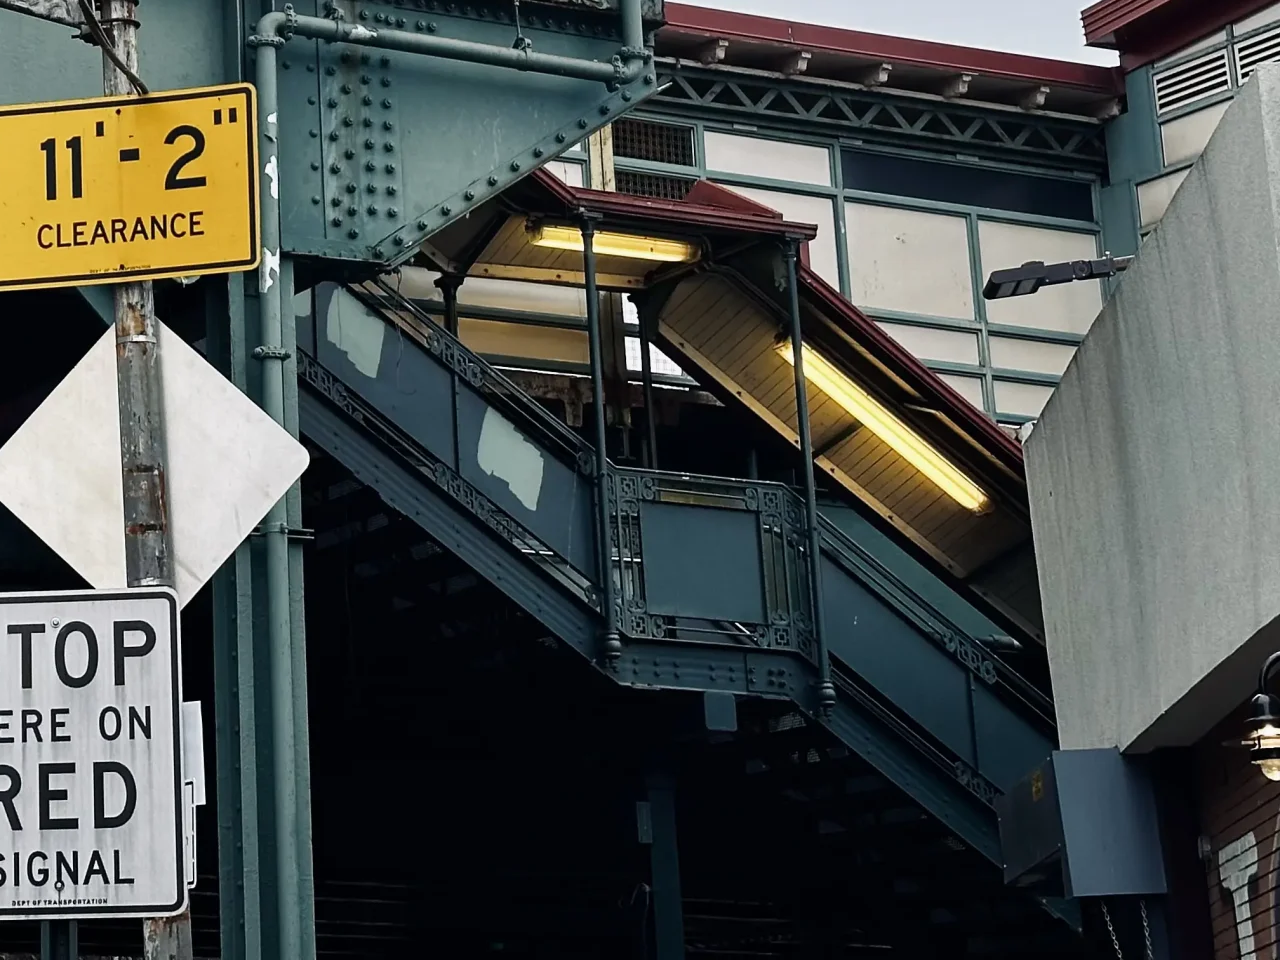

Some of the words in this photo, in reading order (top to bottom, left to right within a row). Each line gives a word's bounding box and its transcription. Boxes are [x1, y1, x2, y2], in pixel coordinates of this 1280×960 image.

[37, 210, 205, 250] CLEARANCE
[98, 705, 152, 742] ON
[43, 898, 108, 906] TRANSPORTATION
